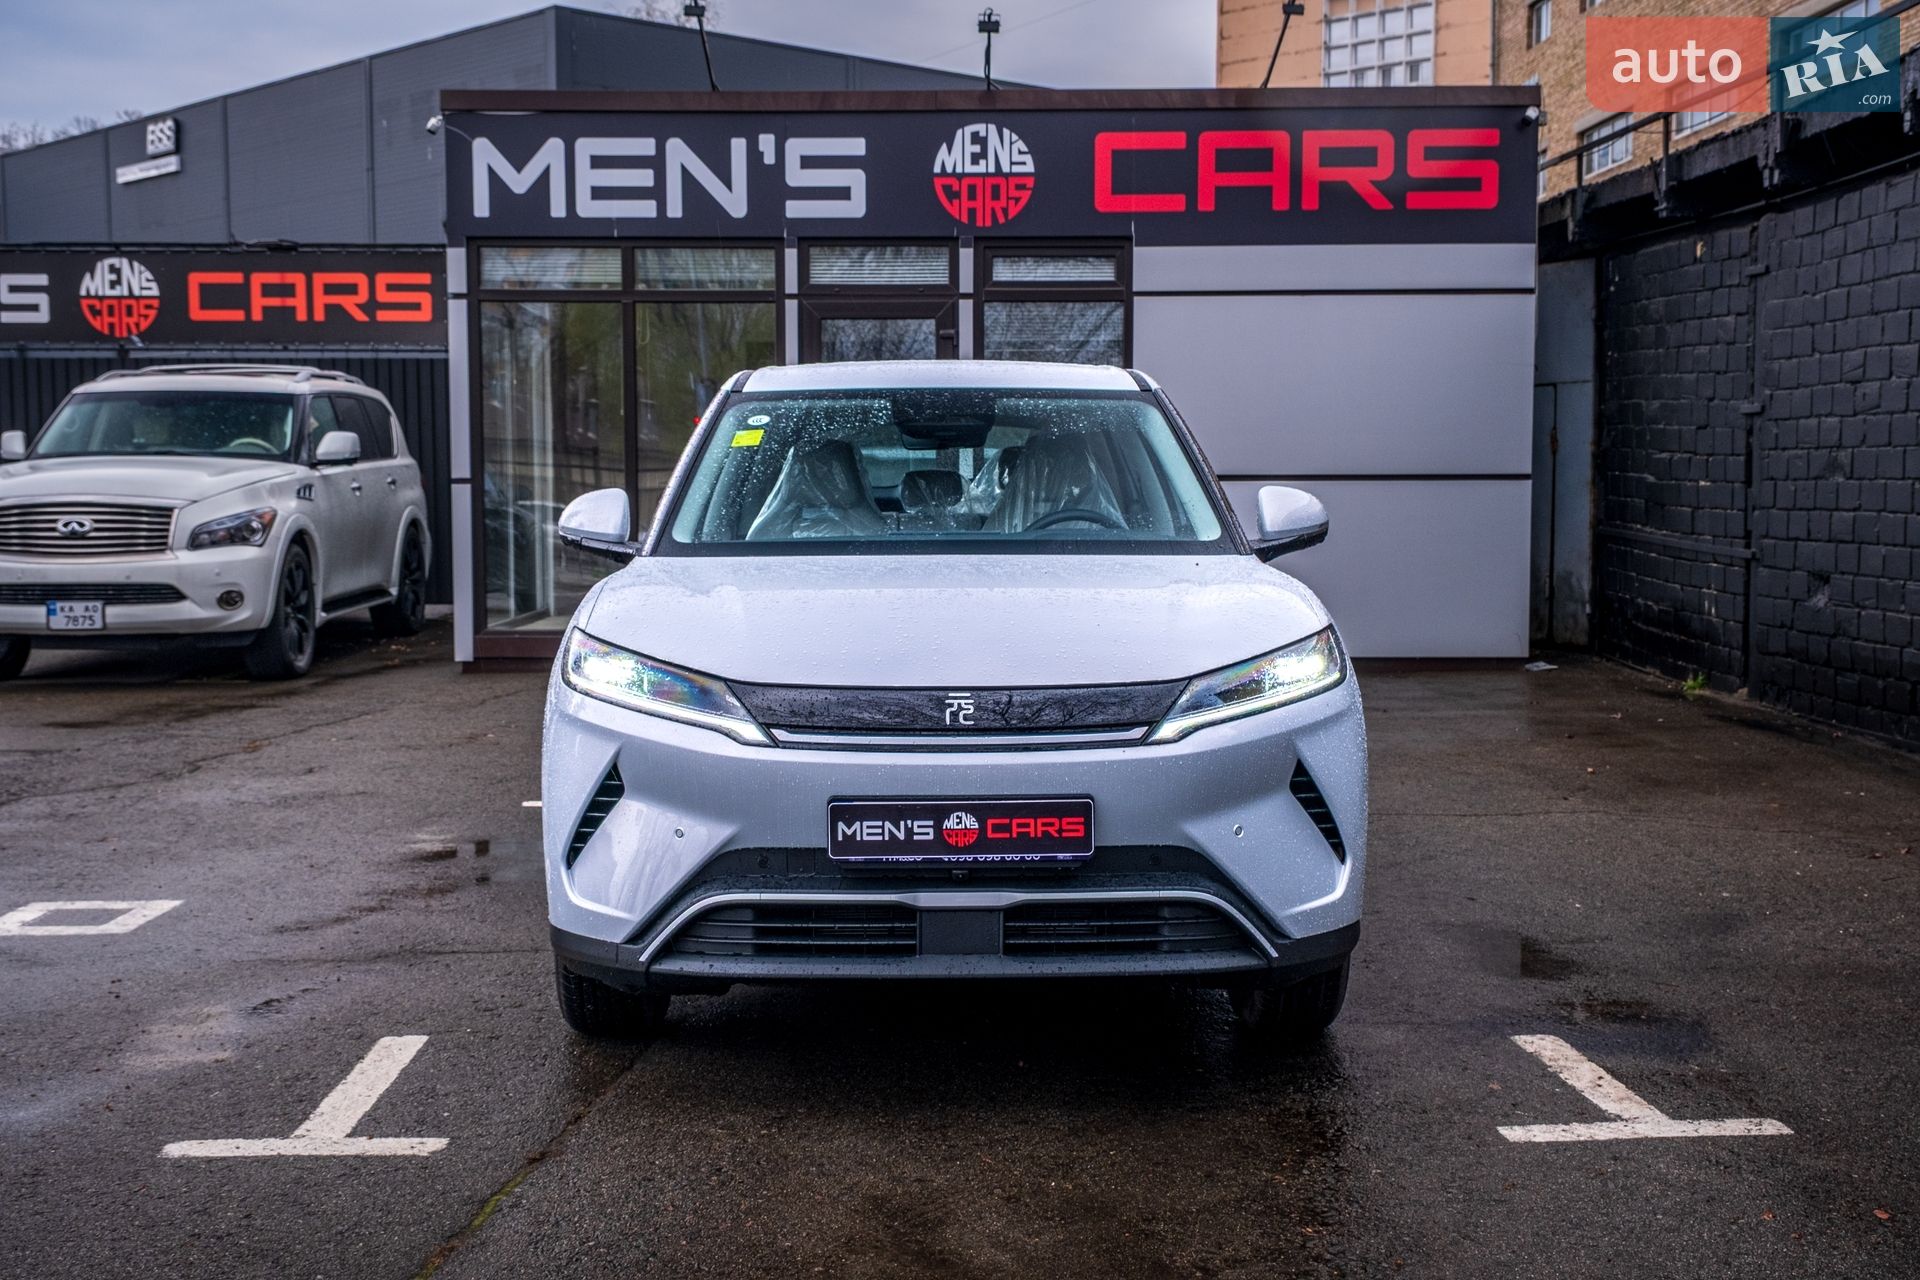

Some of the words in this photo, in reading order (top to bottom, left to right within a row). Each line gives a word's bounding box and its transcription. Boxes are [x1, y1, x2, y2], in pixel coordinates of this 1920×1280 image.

[472, 134, 867, 219] MEN'S
[1093, 127, 1501, 213] CARS
[933, 176, 1035, 227] CARS
[187, 271, 433, 323] CARS
[79, 298, 161, 338] CARS
[64, 615, 96, 627] 7875
[837, 820, 934, 841] MEN'S
[986, 816, 1086, 839] CARS
[942, 829, 980, 848] CARS
